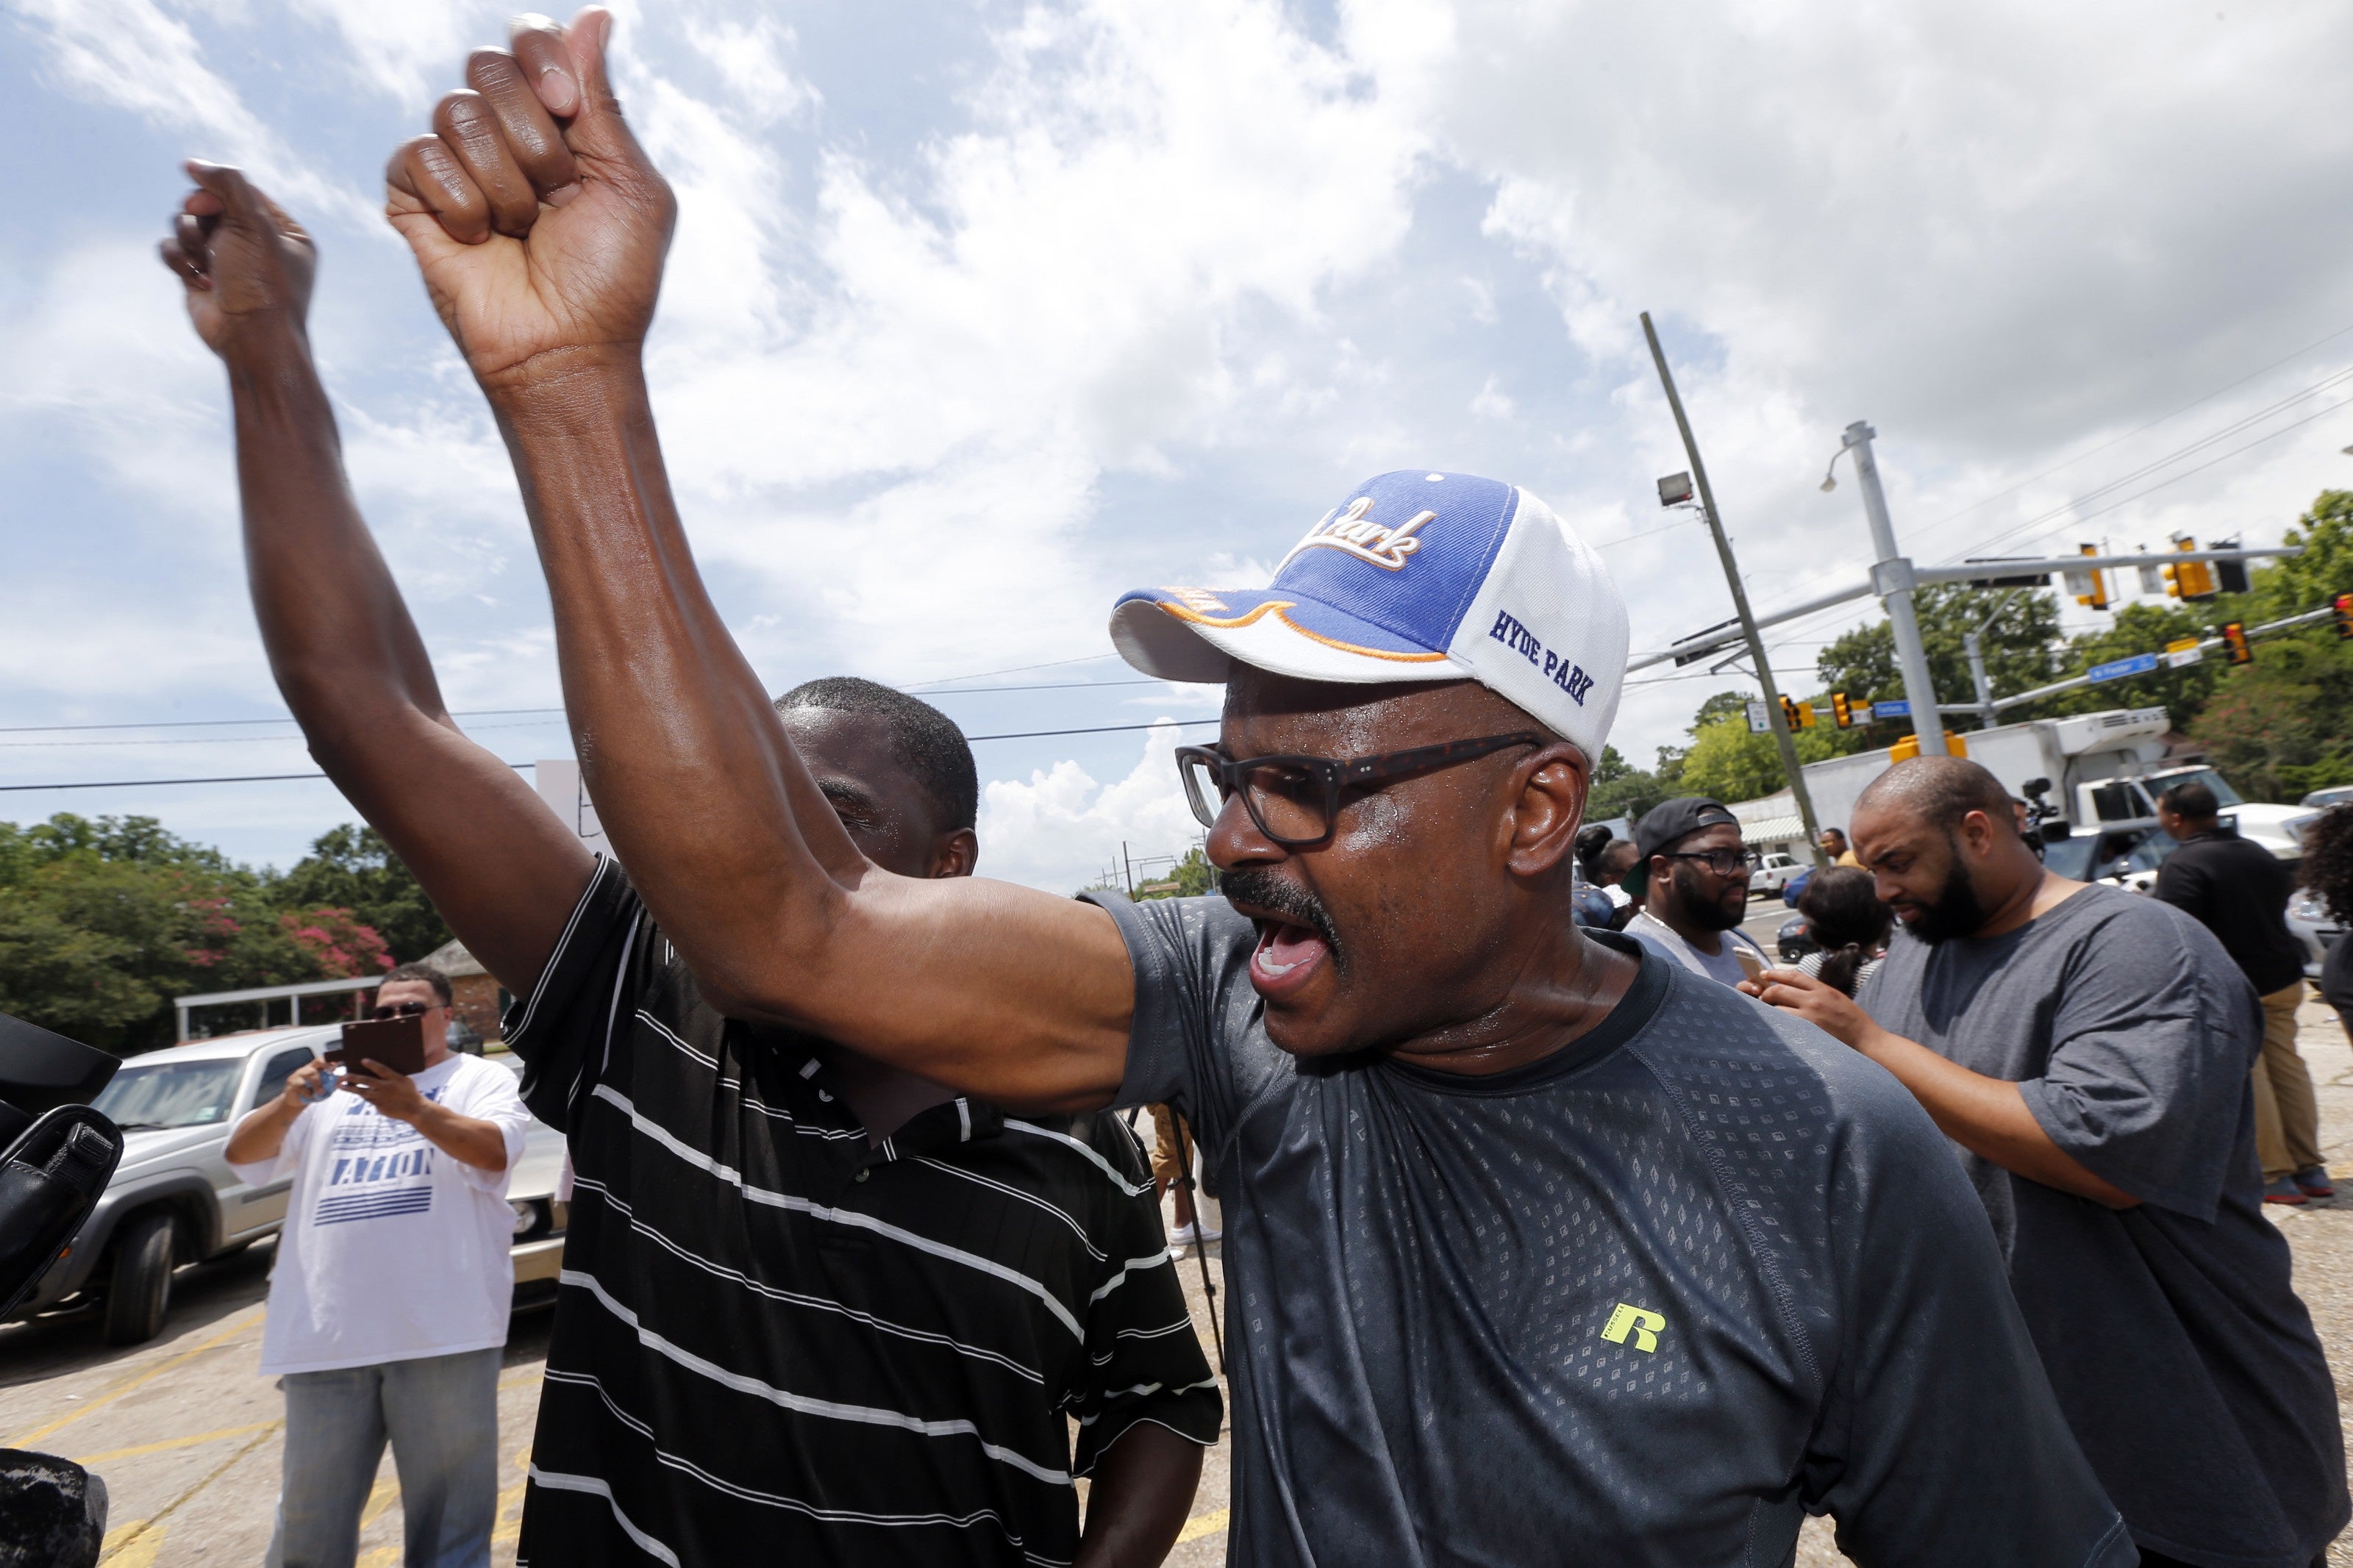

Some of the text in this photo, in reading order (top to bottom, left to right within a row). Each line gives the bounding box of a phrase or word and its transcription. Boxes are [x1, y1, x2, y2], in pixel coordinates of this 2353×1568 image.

[1489, 609, 1595, 707] HYDE PARK
[1604, 1305, 1624, 1338] RUSSELL
